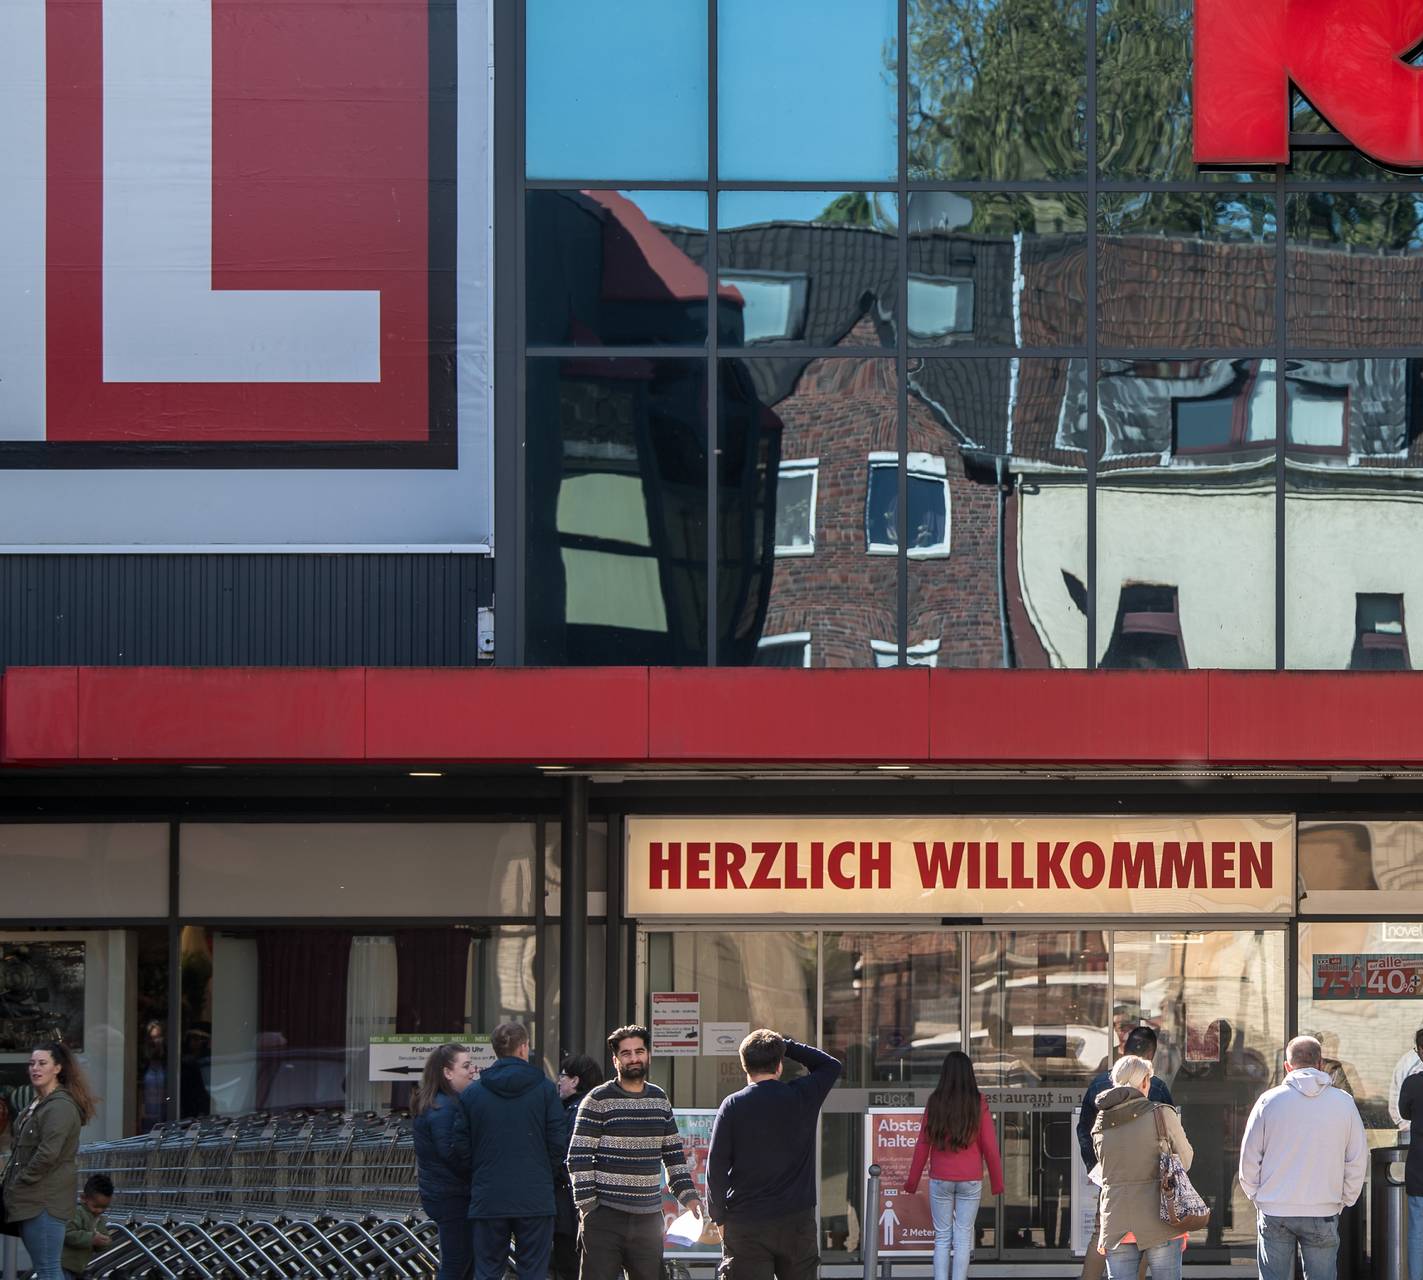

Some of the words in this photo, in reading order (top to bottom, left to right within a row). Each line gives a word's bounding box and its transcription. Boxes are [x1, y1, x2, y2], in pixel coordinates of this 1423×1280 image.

[649, 841, 892, 890] HERZLICH
[914, 841, 1273, 890] WILLKOMMEN
[1379, 956, 1401, 968] alle
[986, 1092, 1054, 1104] estaurant
[1058, 1095, 1072, 1103] im
[910, 1228, 935, 1237] Meter
